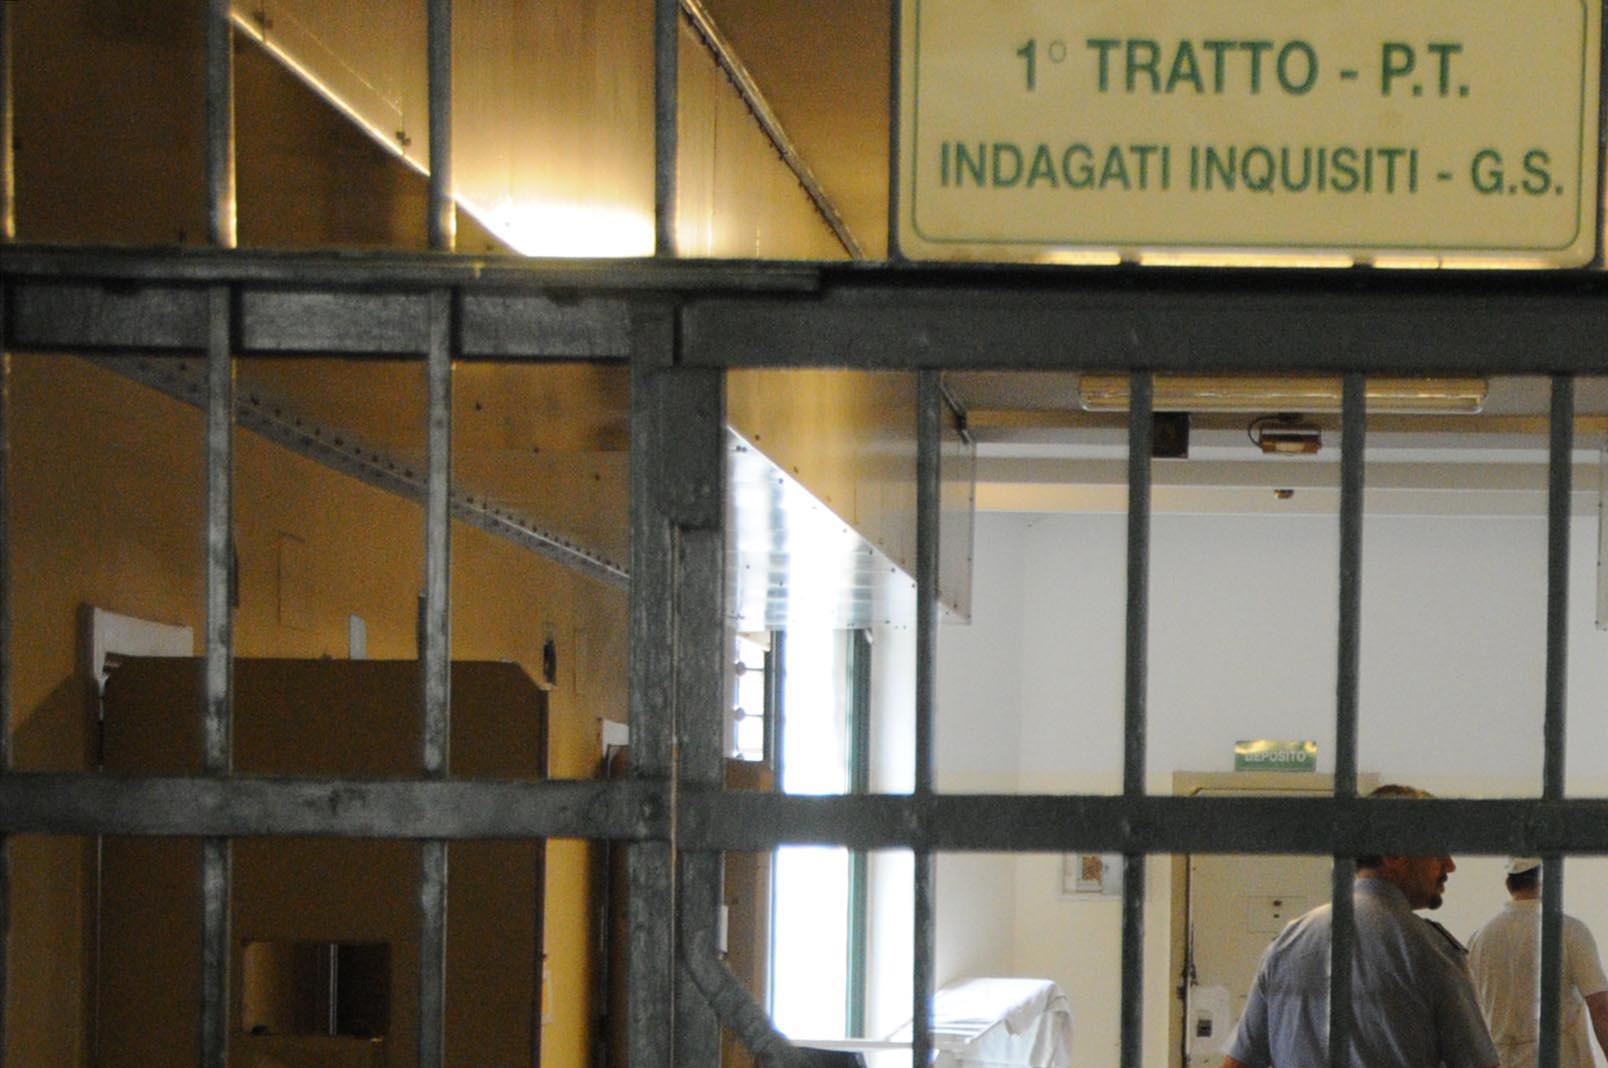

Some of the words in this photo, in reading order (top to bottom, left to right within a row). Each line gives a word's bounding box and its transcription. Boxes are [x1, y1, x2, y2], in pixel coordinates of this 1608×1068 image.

[1085, 37, 1320, 97] TRATTO
[1379, 40, 1470, 98] P.T.
[940, 142, 1171, 190] INDAGATI
[1190, 146, 1419, 196] INQUISITI
[1470, 148, 1564, 196] G.S.
